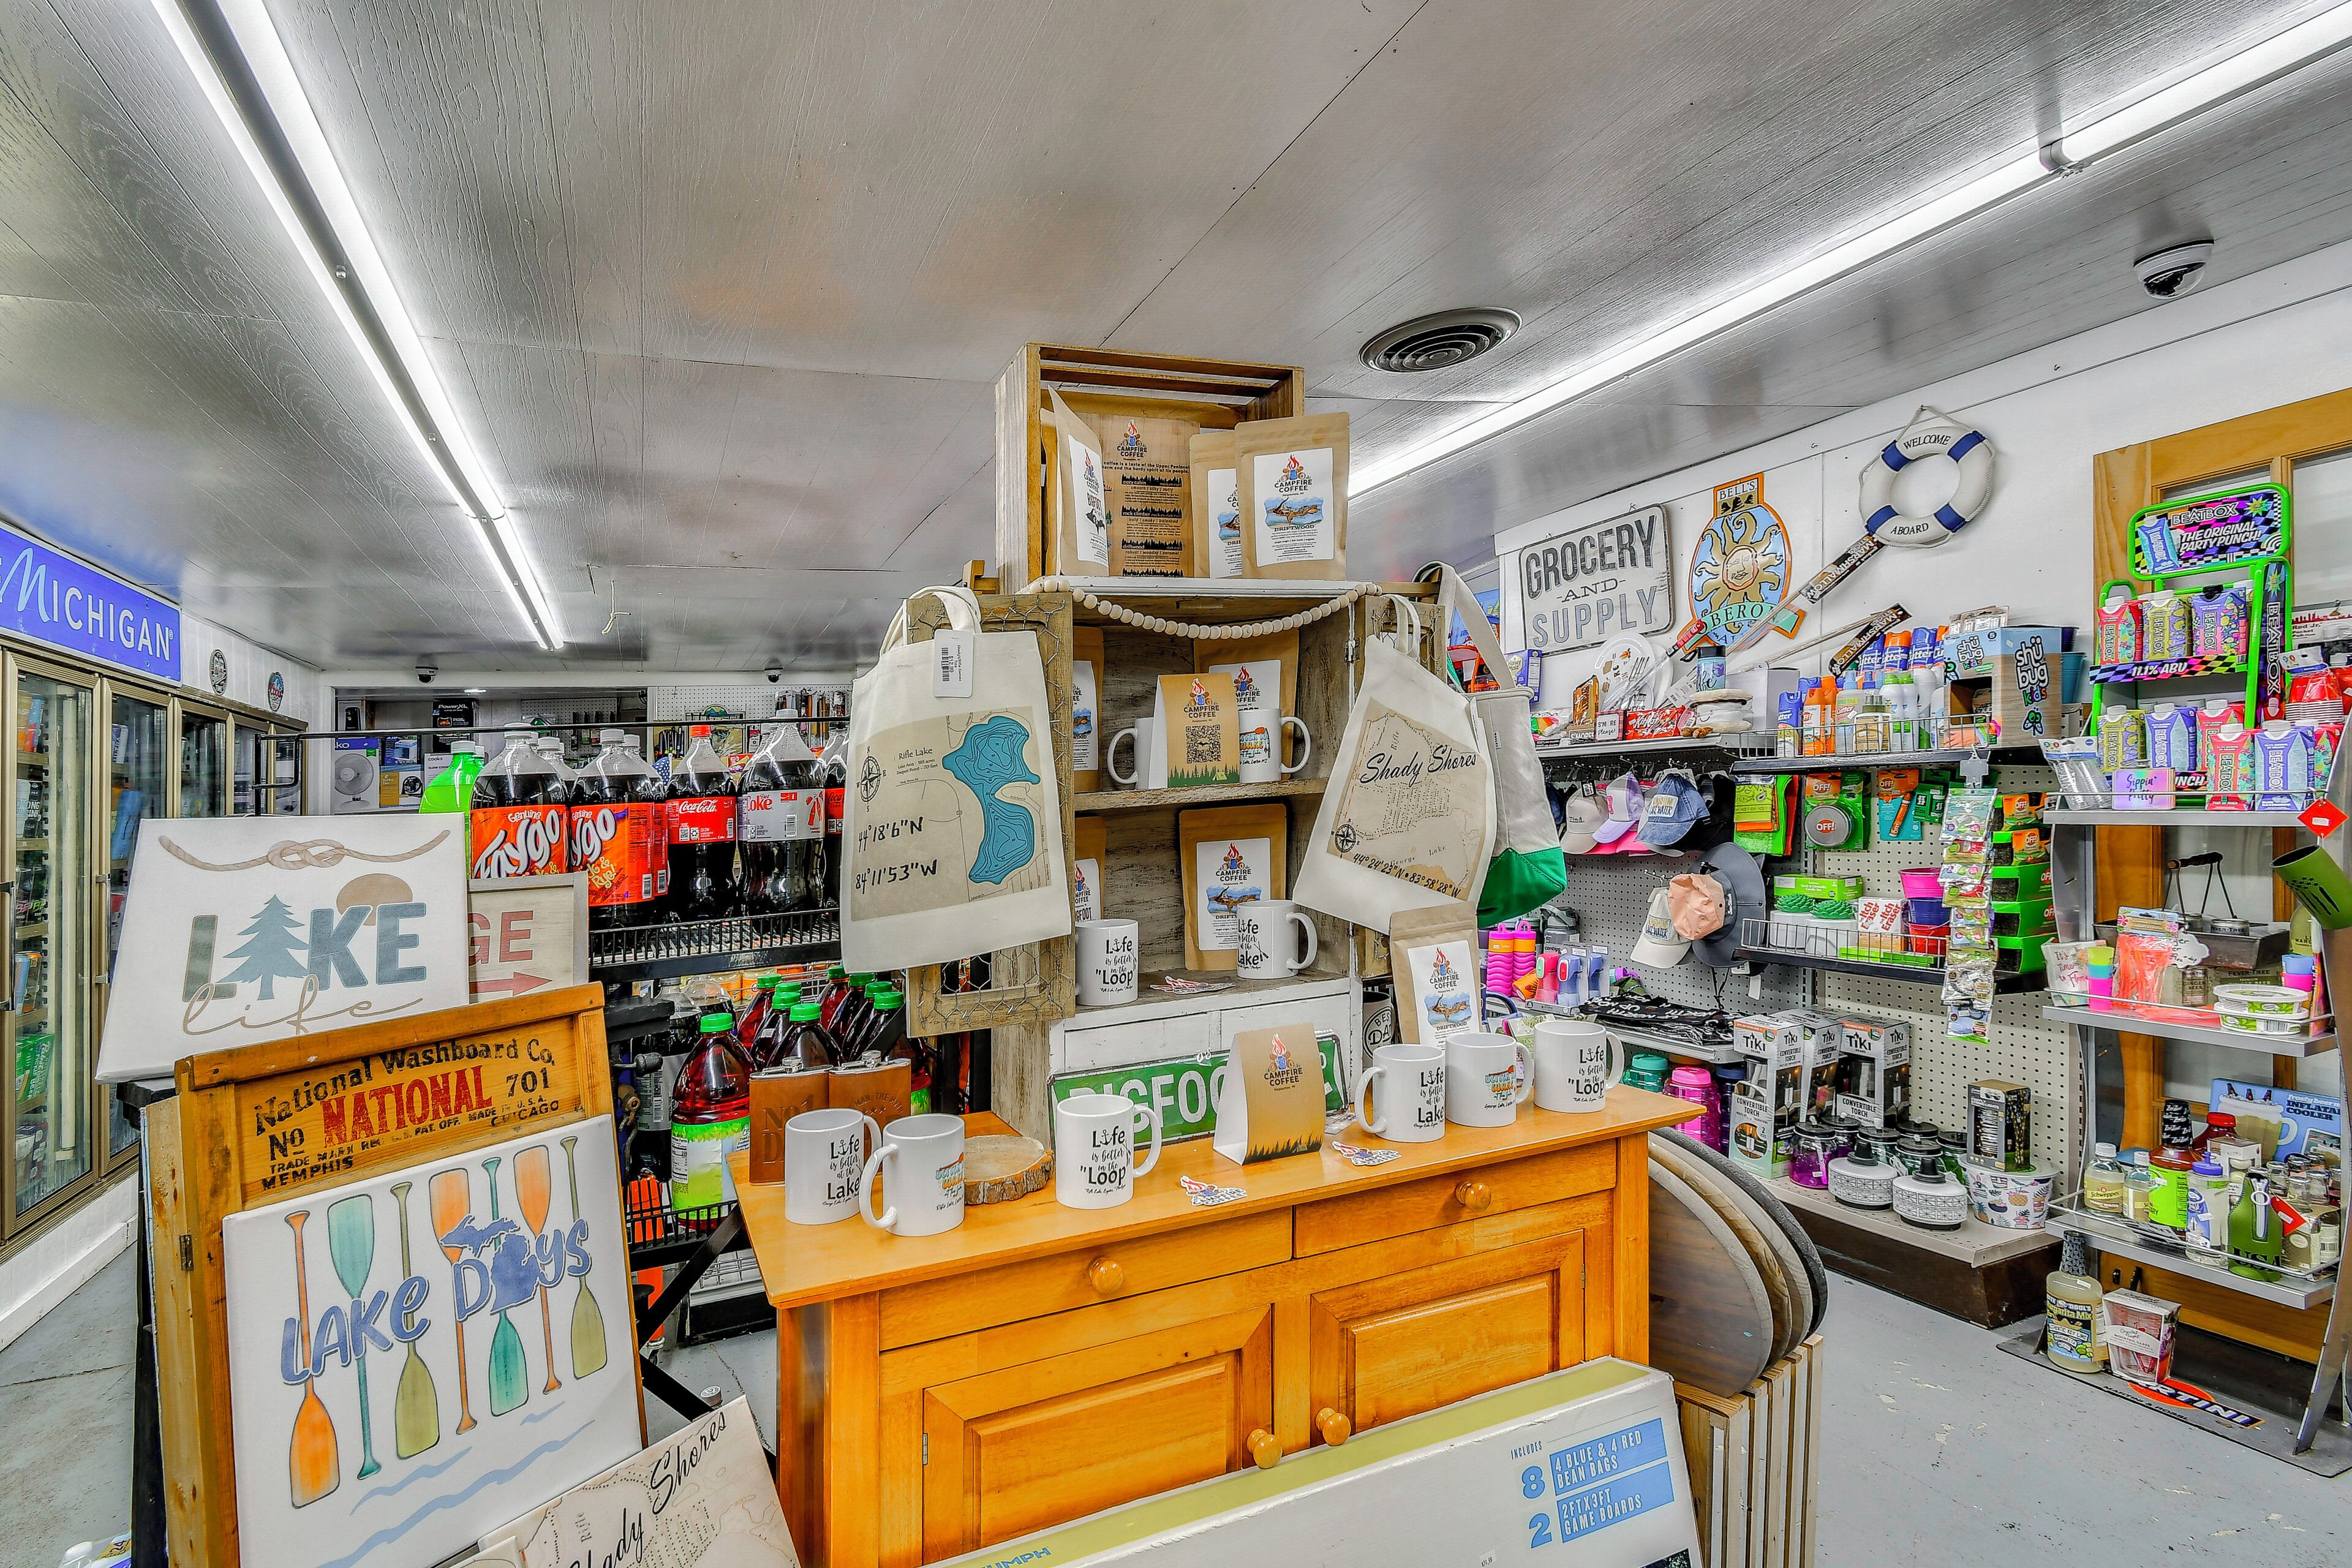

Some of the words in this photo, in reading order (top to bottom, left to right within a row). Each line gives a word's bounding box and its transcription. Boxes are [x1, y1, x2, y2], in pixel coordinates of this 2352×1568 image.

[1903, 434, 1951, 450] WELCOME
[1274, 478, 1313, 488] CAMPFIRE
[2171, 502, 2240, 527] BEATBOX
[1890, 522, 1929, 535] ABOARD
[2180, 532, 2205, 543] THE
[2203, 521, 2258, 538] ORIGINAL
[2179, 537, 2217, 556] PARTY
[2215, 530, 2263, 546] PUNCH!
[1526, 514, 1657, 601] GROCERY
[1804, 539, 1875, 600] MARSHMALLOW
[1561, 579, 1620, 604] AND
[1, 547, 171, 662] MICHIGAN
[1532, 586, 1657, 649] SUPPLY
[2153, 617, 2164, 654] BEATBOX
[2204, 611, 2217, 651] BEATBOX
[2104, 624, 2115, 661] BEATBOX
[2266, 601, 2281, 696] BEATBOX
[1958, 648, 1983, 663] bug
[1962, 660, 1983, 671] kids
[2016, 663, 2049, 690] bug
[2022, 684, 2048, 706] kids
[1183, 704, 1220, 714] CAMPFIRE
[1836, 705, 1855, 715] Cutter
[899, 750, 913, 760] Rifle
[915, 747, 933, 757] Lake
[2107, 732, 2117, 767] BEATBOX
[2155, 729, 2168, 767] BEATBOX
[1359, 750, 1423, 788] Shady
[1427, 744, 1477, 773] Shores
[2218, 753, 2234, 792] BEATBOX
[2267, 750, 2283, 792] BEATBOX
[1812, 782, 1832, 792] OFF!
[1879, 779, 1896, 789] OFF!
[679, 799, 718, 815] Coca-Cola
[2015, 800, 2027, 809] OFF!
[507, 809, 543, 823] Genuine
[1816, 822, 1836, 832] OFF!
[2025, 834, 2037, 844] OFF!
[1859, 901, 1874, 919] Itch
[1881, 902, 1895, 921] Itch
[1881, 903, 1902, 932] Eraser
[1429, 974, 1460, 984] CAMPFIRE
[1433, 981, 1458, 990] COFFEE
[1436, 1021, 1468, 1031] DRIFTWOOD
[505, 1067, 551, 1098] 701
[1263, 1067, 1303, 1081] CAMPFIRE
[1269, 1075, 1300, 1087] COFFEE
[255, 1055, 374, 1137] National
[379, 1038, 519, 1075] Washboard
[320, 1065, 492, 1149] NATIONAL
[1417, 1104, 1444, 1124] Lake
[1736, 1097, 1768, 1114] CONVERTIBLE
[1743, 1106, 1760, 1118] TORCH
[1842, 1097, 1877, 1114] CONVERTIBLE
[1850, 1107, 1869, 1118] TORCH
[2285, 1106, 2334, 1121] COOLER
[270, 1155, 311, 1175] TRADE
[468, 1106, 497, 1122] MADE
[1101, 1148, 1125, 1163] better
[261, 1156, 353, 1191] MEMPHIS
[827, 1175, 860, 1200] Lake
[2076, 1311, 2093, 1321] Mix
[279, 1275, 430, 1387] LAKE
[2103, 1385, 2144, 1403] MARTINI
[1510, 1440, 1543, 1460] INCLUDES
[1555, 1457, 1562, 1472] 4
[1566, 1446, 1593, 1469] BLUE
[1597, 1442, 1607, 1458] &
[1610, 1438, 1618, 1453] 4
[1621, 1429, 1643, 1450] RED
[650, 1411, 726, 1515] Shores
[1556, 1464, 1586, 1490] BEAN
[1589, 1454, 1618, 1478] BAGS
[1521, 1465, 1546, 1499] 8
[1561, 1488, 1611, 1520] 2FTX3FT
[1563, 1510, 1596, 1536] GAME
[1599, 1493, 1643, 1523] BOARDS
[1528, 1512, 1553, 1549] 2
